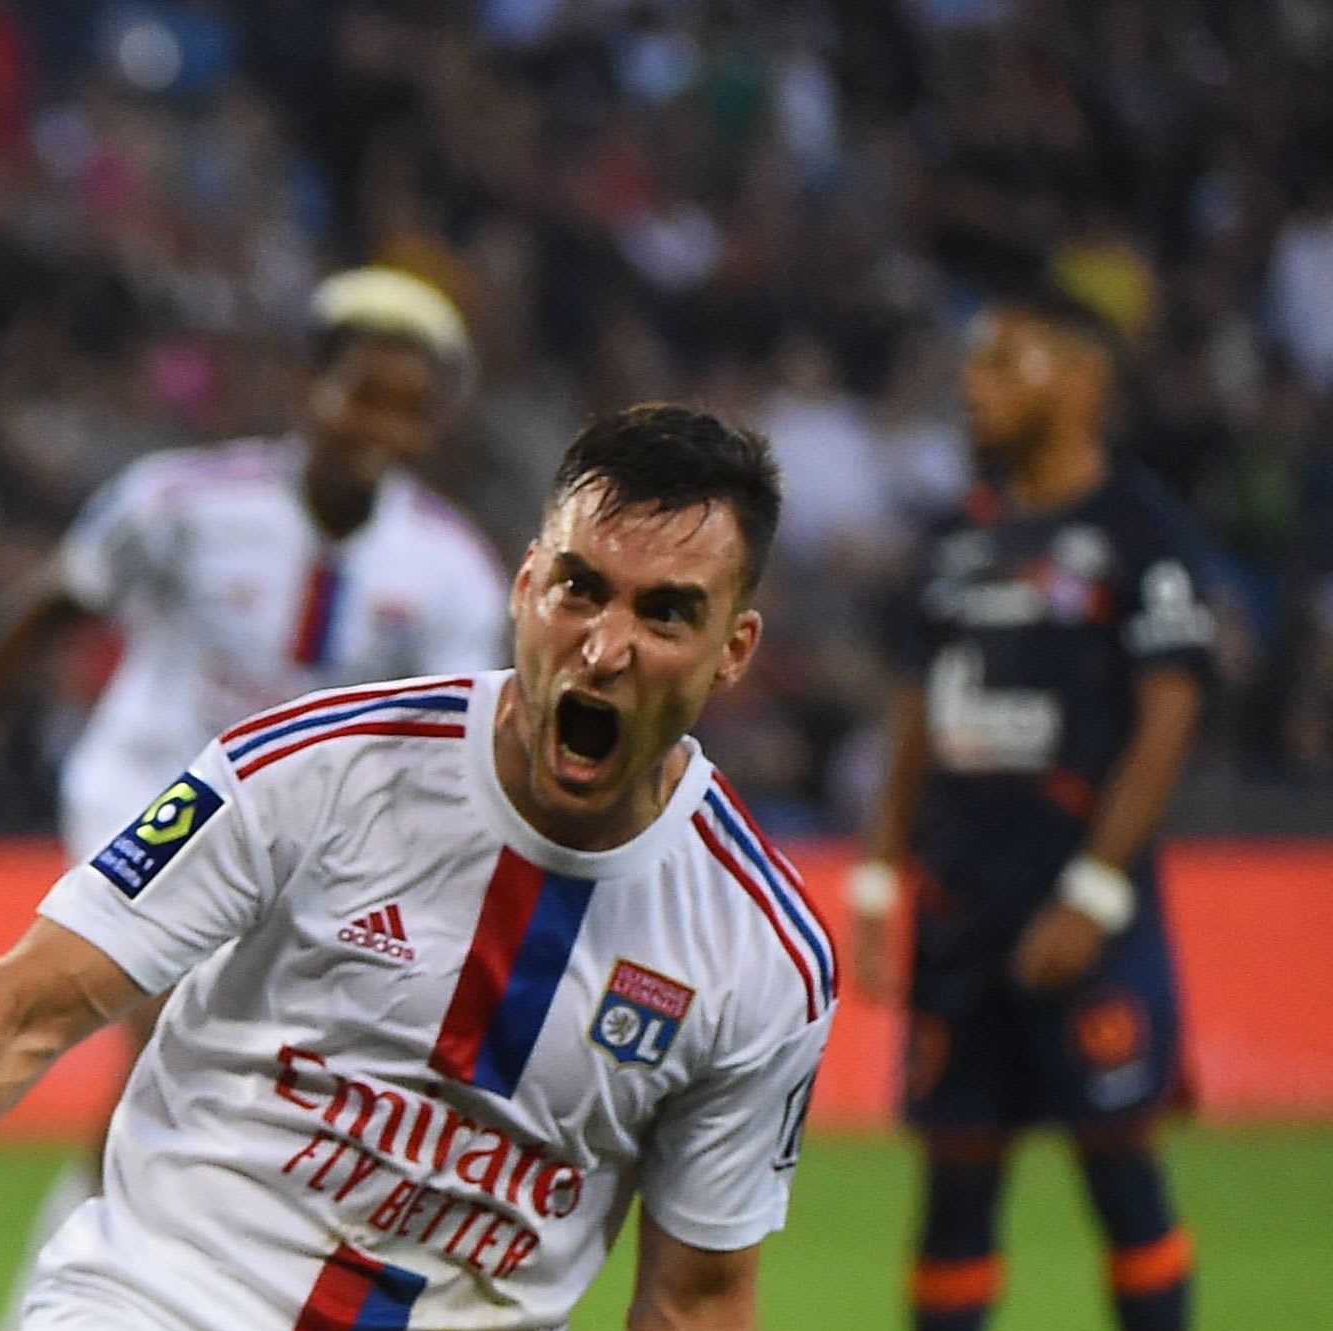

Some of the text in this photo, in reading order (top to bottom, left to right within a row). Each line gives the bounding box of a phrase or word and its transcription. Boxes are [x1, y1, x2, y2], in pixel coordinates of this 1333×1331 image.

[337, 928, 414, 961] adidas
[281, 1130, 541, 1279] FLY BETTER
